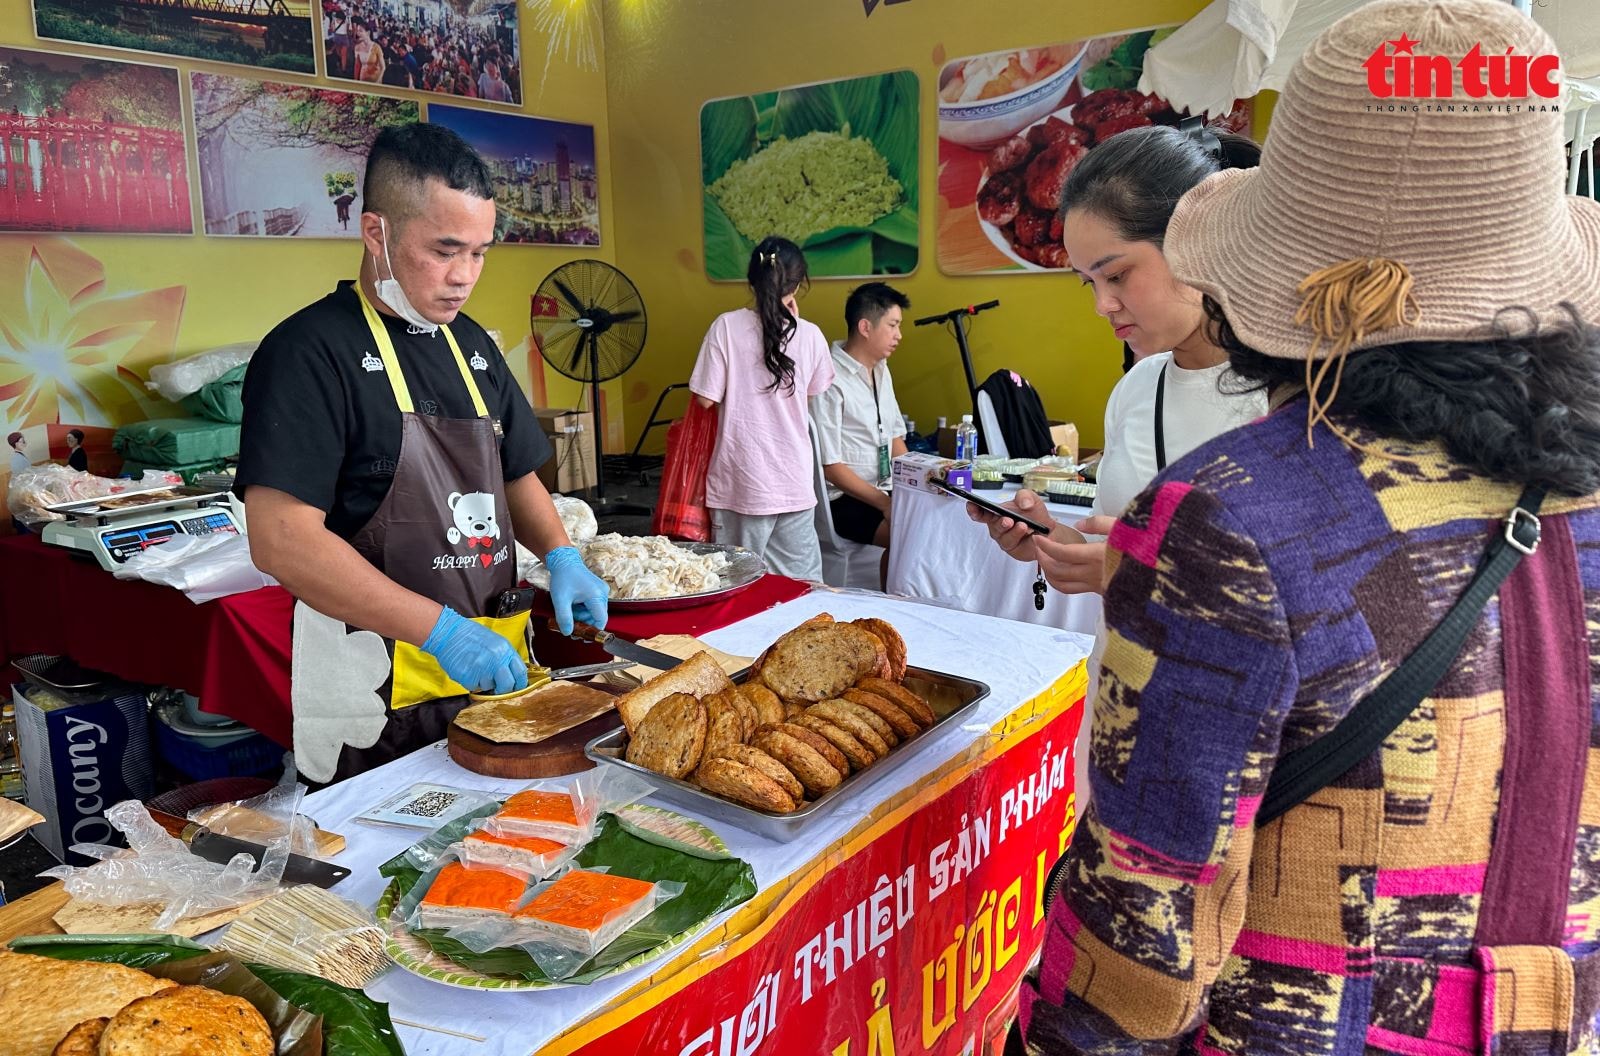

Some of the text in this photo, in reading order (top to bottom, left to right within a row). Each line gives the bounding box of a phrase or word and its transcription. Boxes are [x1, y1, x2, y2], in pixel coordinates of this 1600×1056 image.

[432, 554, 479, 569] HAPPY
[794, 864, 915, 1005] THIỆU
[928, 807, 992, 902] SẢN
[999, 740, 1068, 844] PHẨM
[831, 977, 896, 1056] Ả
[922, 876, 1021, 1050] ƯỚC
